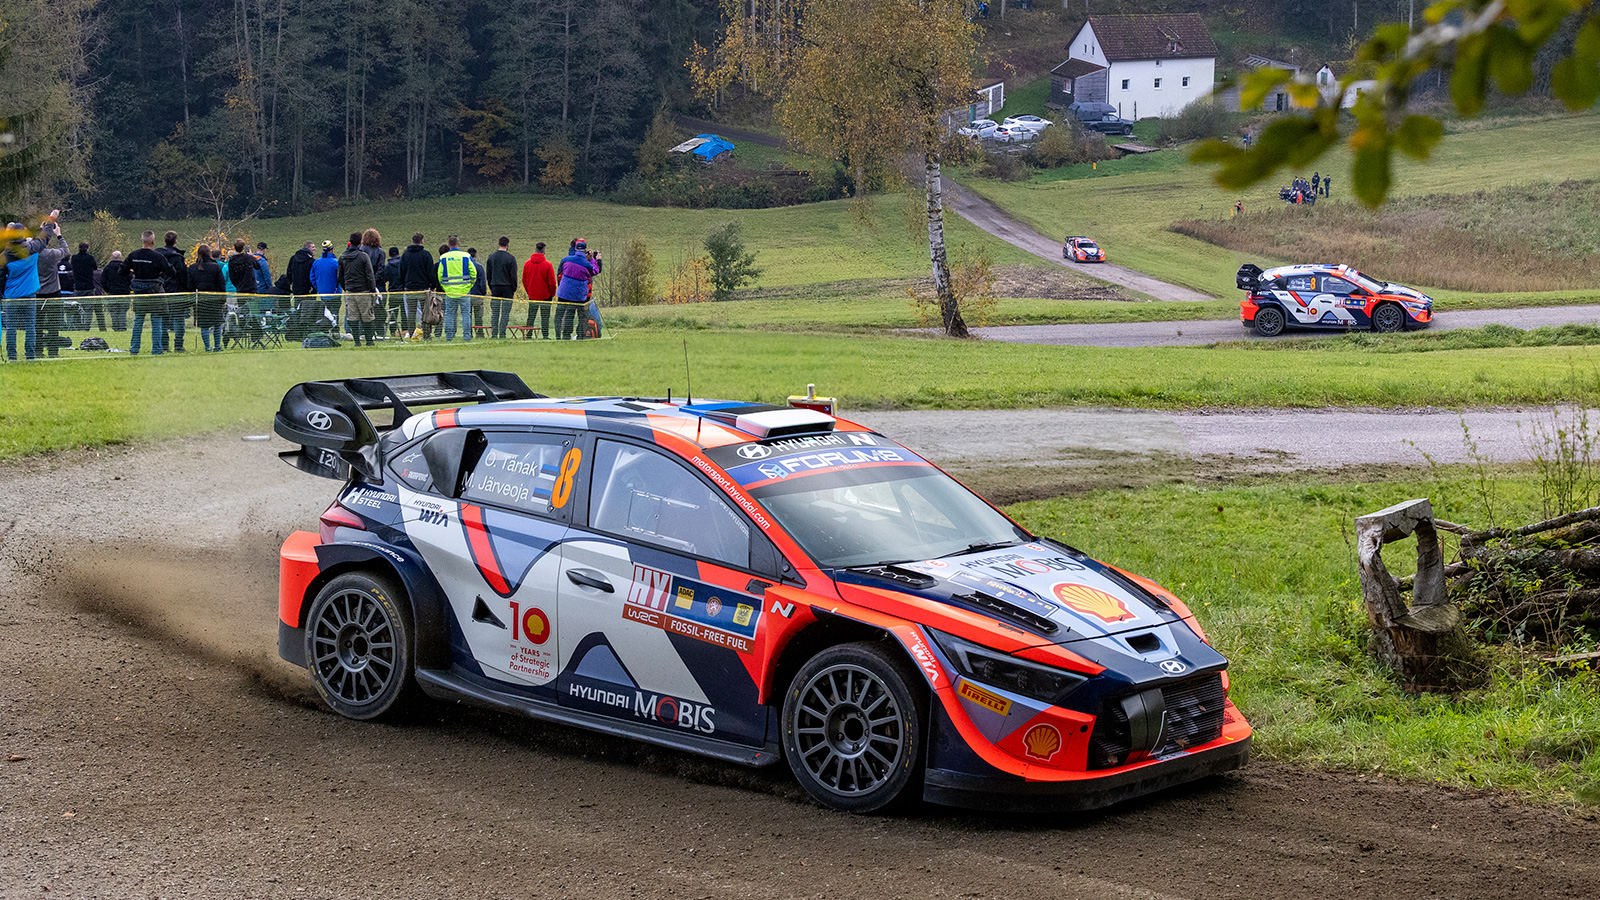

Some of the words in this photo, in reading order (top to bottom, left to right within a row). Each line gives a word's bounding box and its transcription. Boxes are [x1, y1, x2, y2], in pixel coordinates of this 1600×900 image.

[1311, 277, 1316, 290] 8
[397, 388, 463, 397] HYUNDAI
[771, 433, 847, 452] HYUNDAI
[484, 451, 496, 468] O.
[501, 454, 538, 476] Tänak
[779, 449, 905, 472] FORUM8
[461, 471, 475, 488] M.
[478, 475, 529, 502] Järveoja
[551, 447, 582, 509] 8
[362, 489, 398, 503] HYUNDAI
[691, 455, 771, 530] motorsport.hyundai.com
[358, 497, 381, 509] STEEL
[413, 499, 442, 510] HYUNDAI
[419, 508, 448, 527] WIA
[960, 553, 1025, 569] HYUNDAI
[989, 557, 1086, 579] MOBIS
[678, 587, 694, 598] ADAC
[509, 601, 551, 645] 10
[628, 608, 659, 625] WRC
[670, 619, 725, 644] FOSSIL-FREE
[726, 636, 748, 651] FUEL
[520, 646, 540, 657] YEARS
[910, 631, 936, 663] HYUNDAI
[509, 661, 550, 679] Partnership
[511, 653, 518, 661] of
[519, 654, 550, 669] Strategic
[911, 643, 939, 682] WIA
[961, 683, 1007, 712] PIRELLI
[569, 683, 629, 709] HYUNDAI
[634, 690, 716, 734] MOBIS
